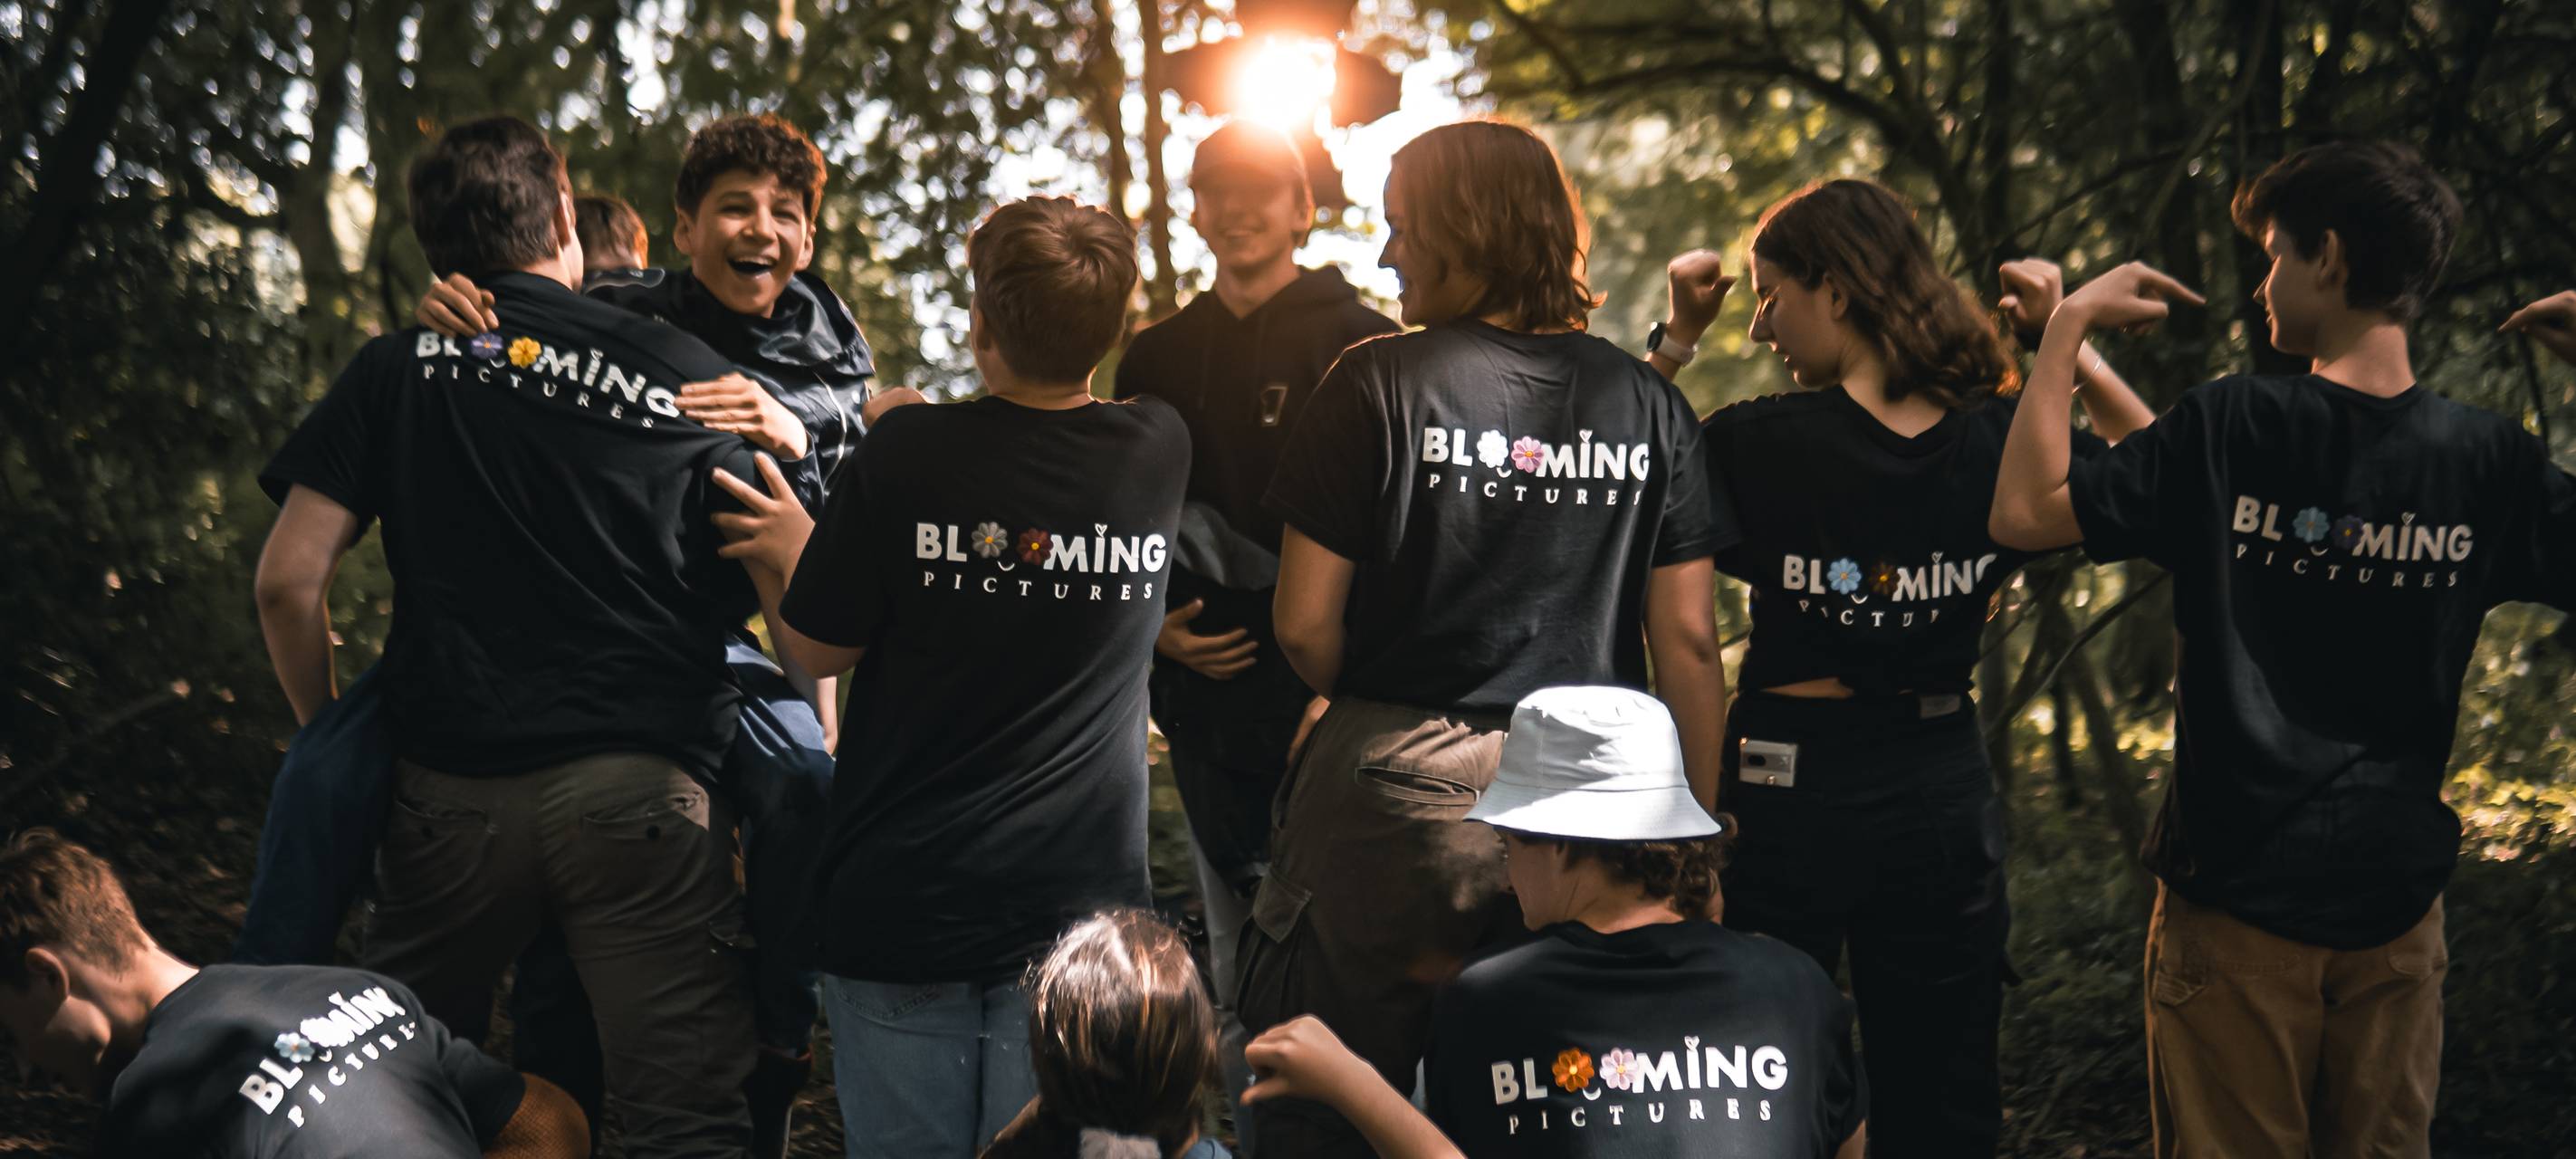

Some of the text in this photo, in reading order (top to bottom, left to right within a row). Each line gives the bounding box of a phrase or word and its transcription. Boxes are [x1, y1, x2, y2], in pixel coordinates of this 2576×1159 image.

[424, 364, 655, 428] PICTURES
[916, 522, 1167, 573] BLOOMING
[2233, 494, 2474, 562] BLOOMING
[924, 570, 1154, 600] PICTURES
[2236, 543, 2458, 588] PICTURES
[238, 985, 407, 1116] BLOOMIN
[1491, 1035, 1788, 1106] BLOOMING
[1509, 1097, 1772, 1135] PICTURES
